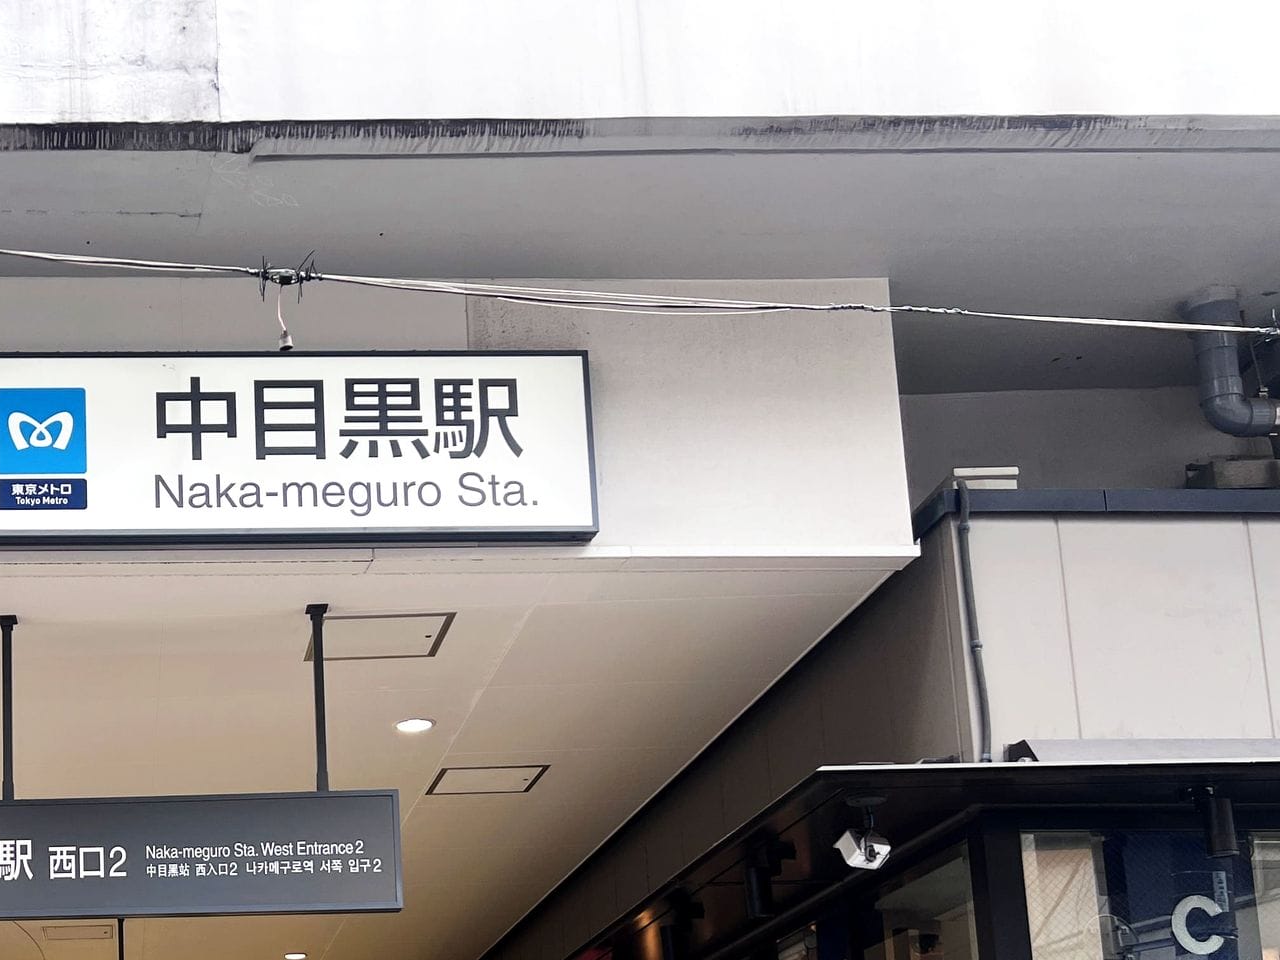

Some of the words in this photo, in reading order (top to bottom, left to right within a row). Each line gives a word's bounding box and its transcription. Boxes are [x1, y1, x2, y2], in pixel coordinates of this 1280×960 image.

[155, 376, 524, 460] 中目黒駅
[10, 483, 72, 496] 東京メトロ
[153, 474, 442, 517] Naka-meguro
[457, 471, 539, 507] Sta.
[15, 496, 41, 507] Tokyo
[43, 496, 69, 505] Metro
[145, 845, 231, 861] Naka-meguro
[234, 842, 259, 858] Sta.
[260, 842, 294, 857] West
[49, 846, 127, 881] 西口2
[195, 862, 238, 877] 西入口2
[246, 860, 314, 875] 나카메구로역
[320, 860, 343, 873] 서쪽
